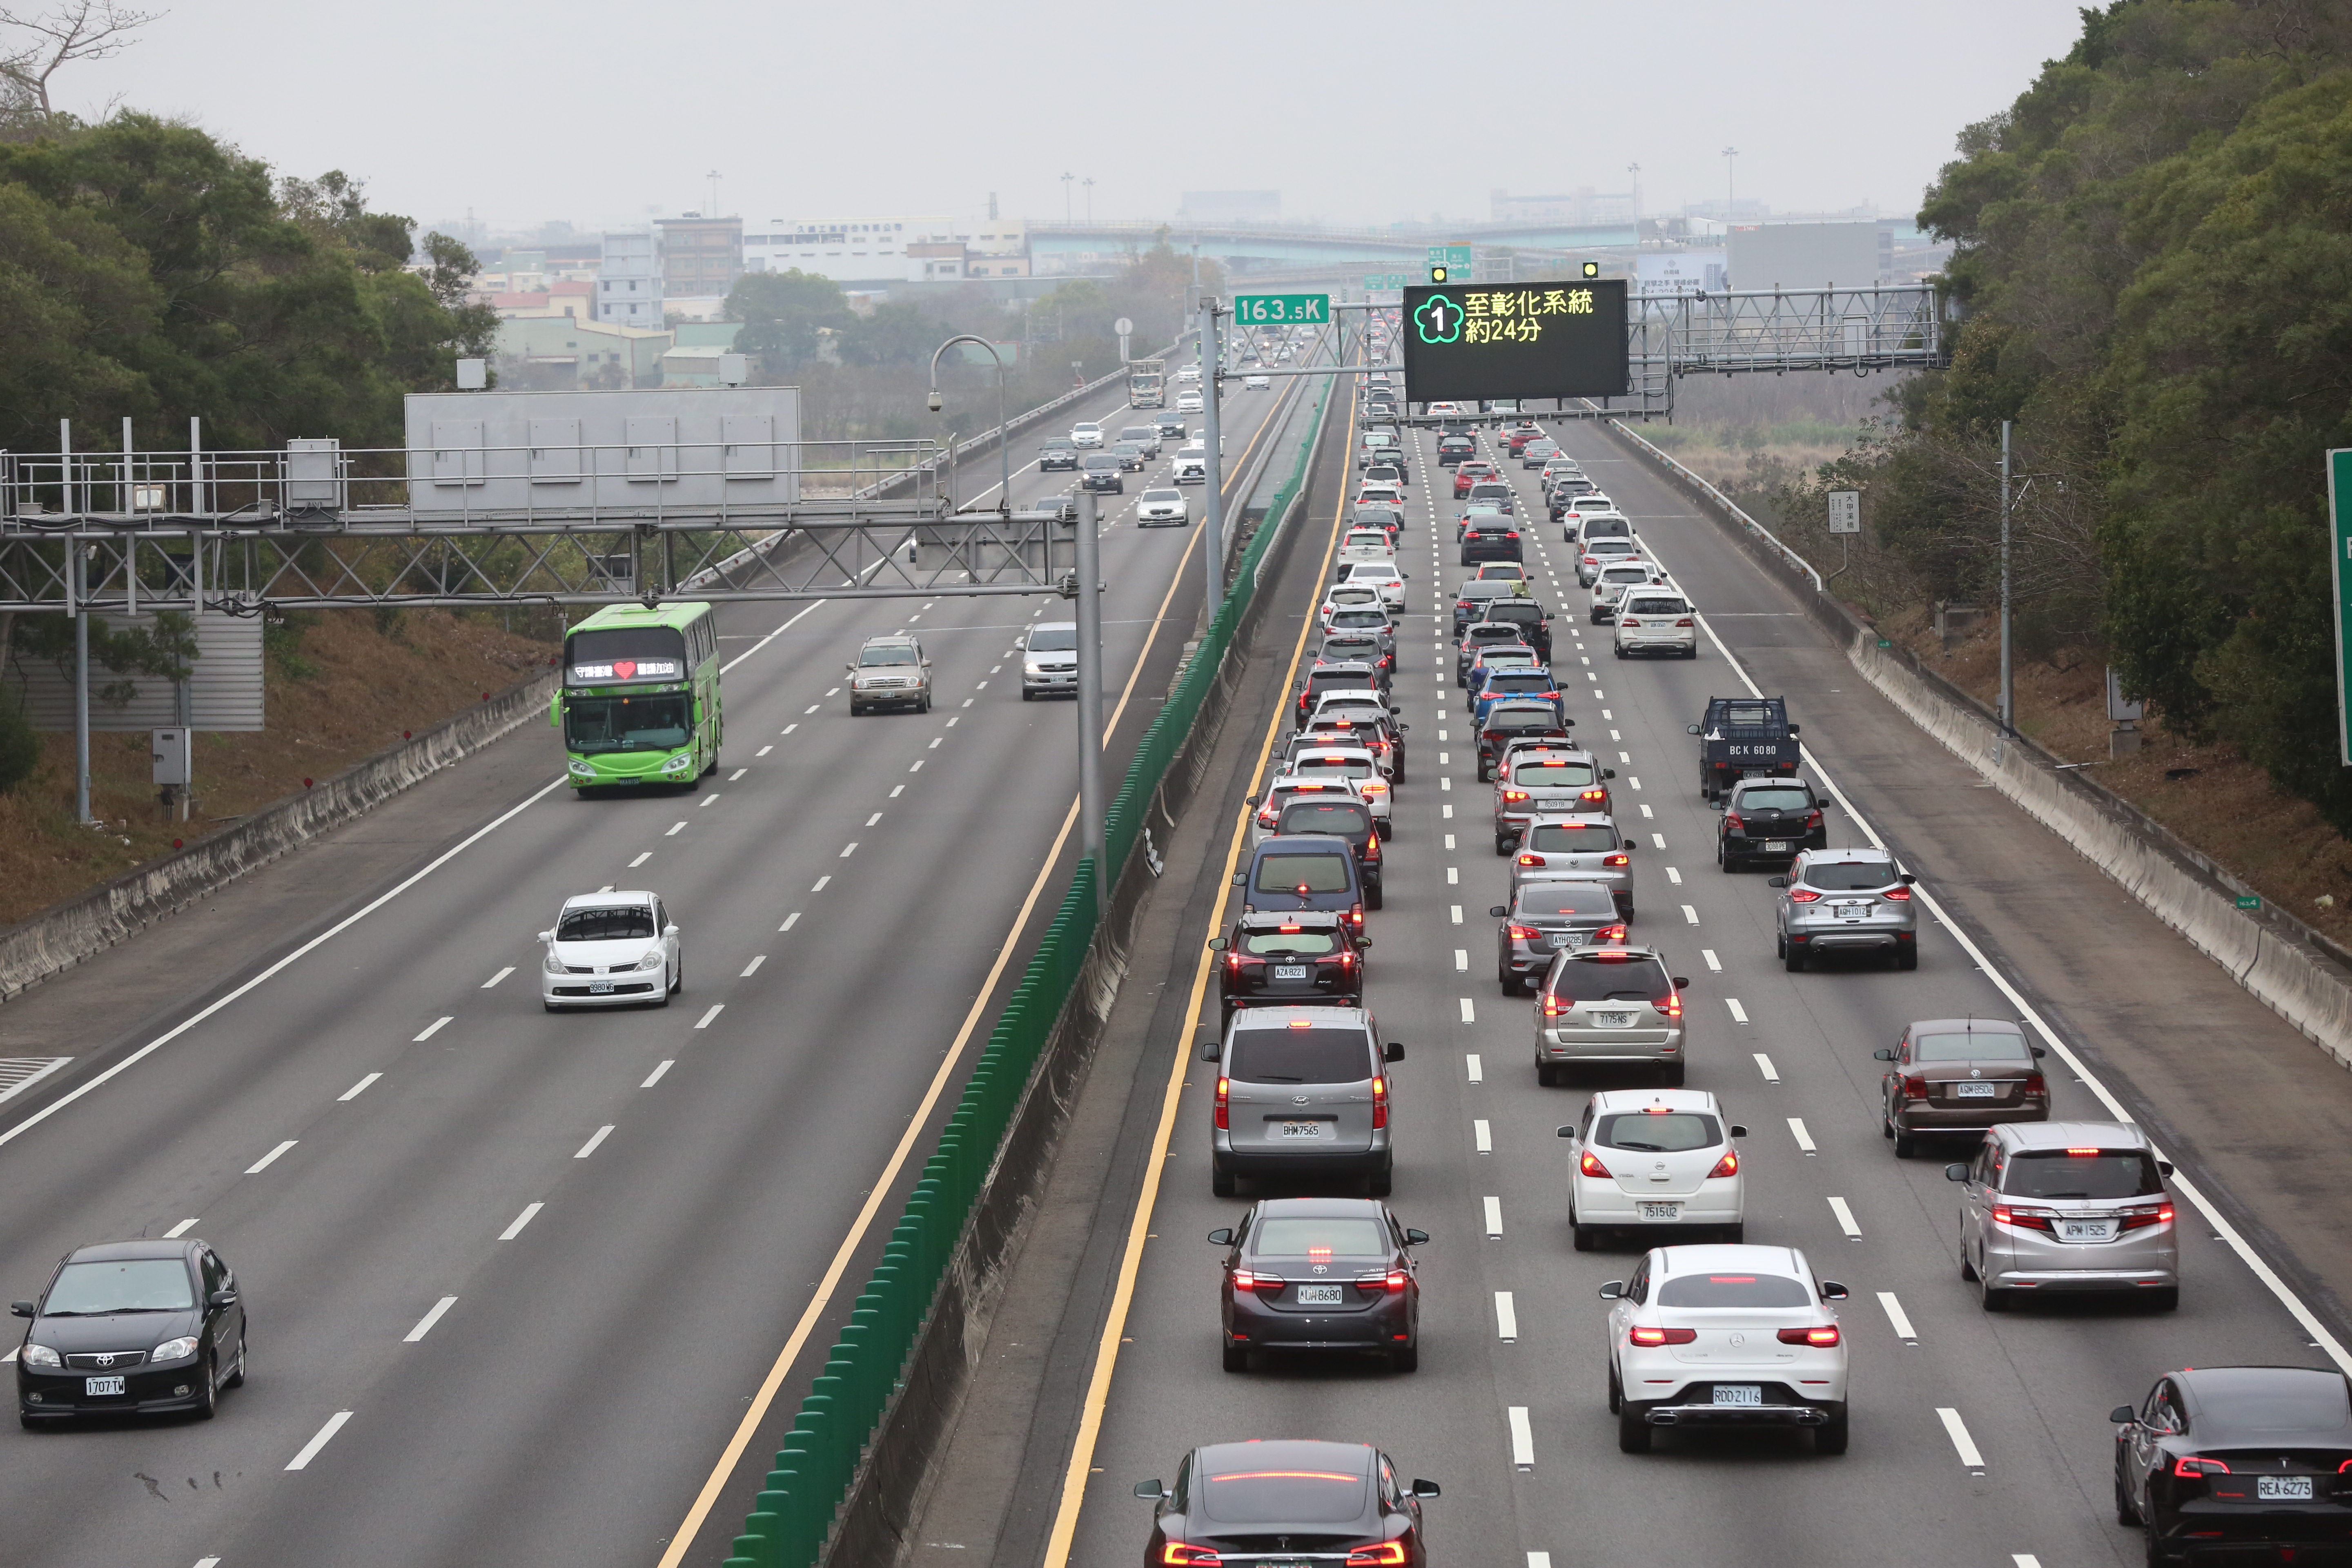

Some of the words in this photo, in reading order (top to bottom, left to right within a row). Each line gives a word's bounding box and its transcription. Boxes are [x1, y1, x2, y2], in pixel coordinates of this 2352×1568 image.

[1241, 299, 1321, 320] 163.5K
[1464, 288, 1593, 317] 至彰化系統
[1431, 306, 1444, 332] 1
[1464, 317, 1542, 344] 約24分
[1846, 494, 1854, 529] 大甲溪橋
[575, 664, 613, 678] 守護臺灣
[637, 662, 675, 675] 醫護加油
[1276, 968, 1304, 976] AZA-8221
[1283, 1126, 1319, 1135] BHM-7565
[1715, 1390, 1760, 1403] RDD-2116
[2260, 1482, 2310, 1495] REA-6273
